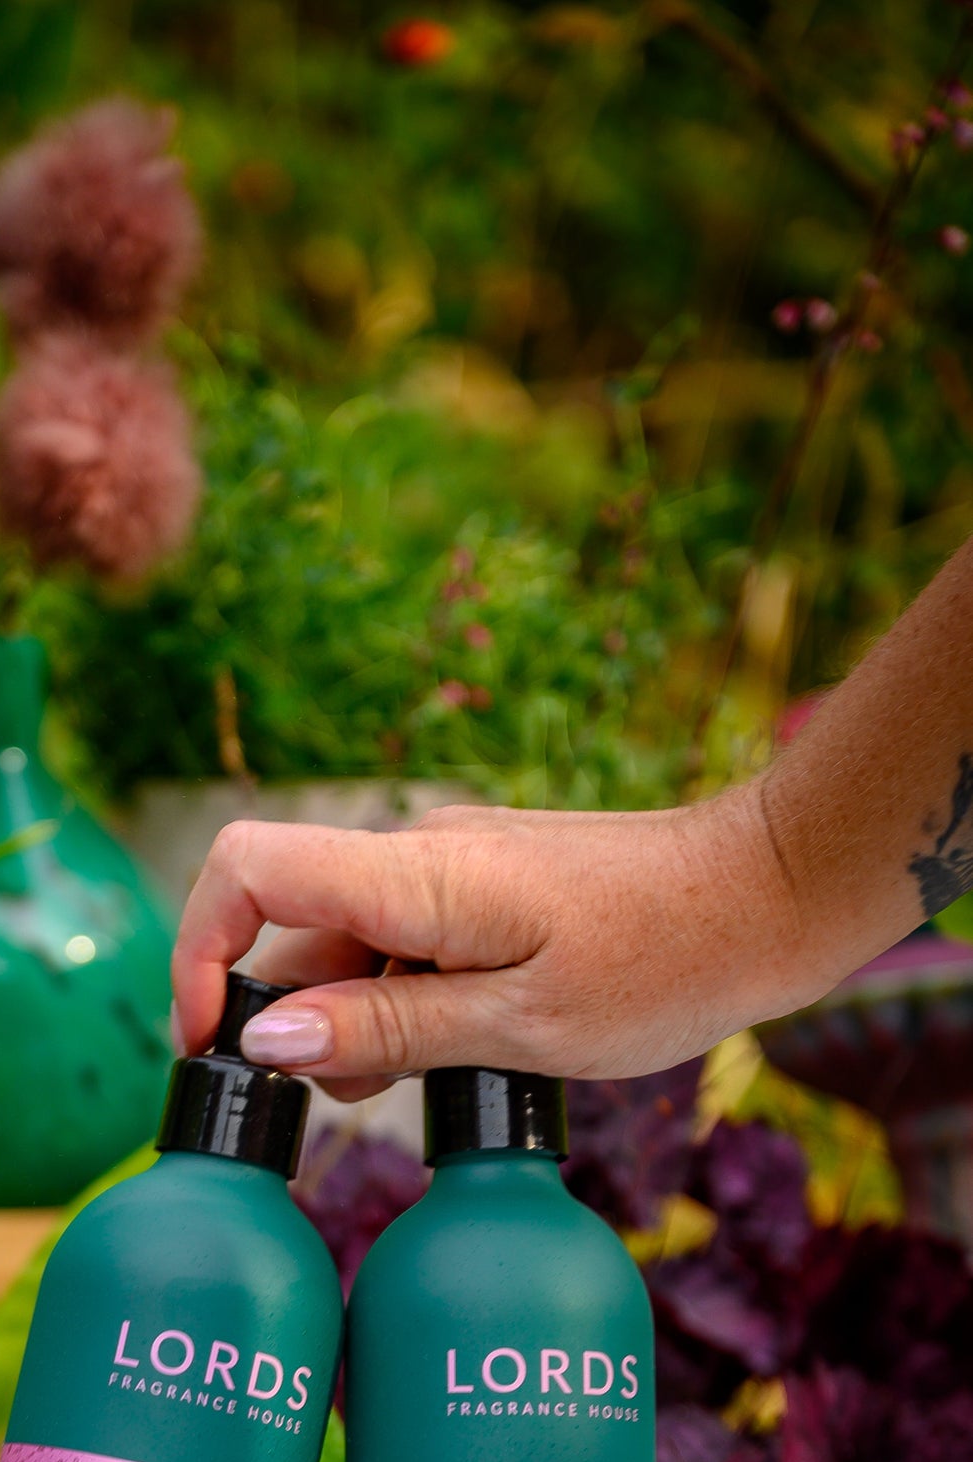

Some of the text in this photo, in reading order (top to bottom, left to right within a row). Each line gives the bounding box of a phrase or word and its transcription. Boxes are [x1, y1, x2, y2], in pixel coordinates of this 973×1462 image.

[113, 1319, 313, 1411] LORDS
[446, 1347, 639, 1400] LORDS
[107, 1371, 303, 1435] FRAGRANCE HOUSE
[446, 1401, 640, 1422] FRAGRANCE HOUSE
